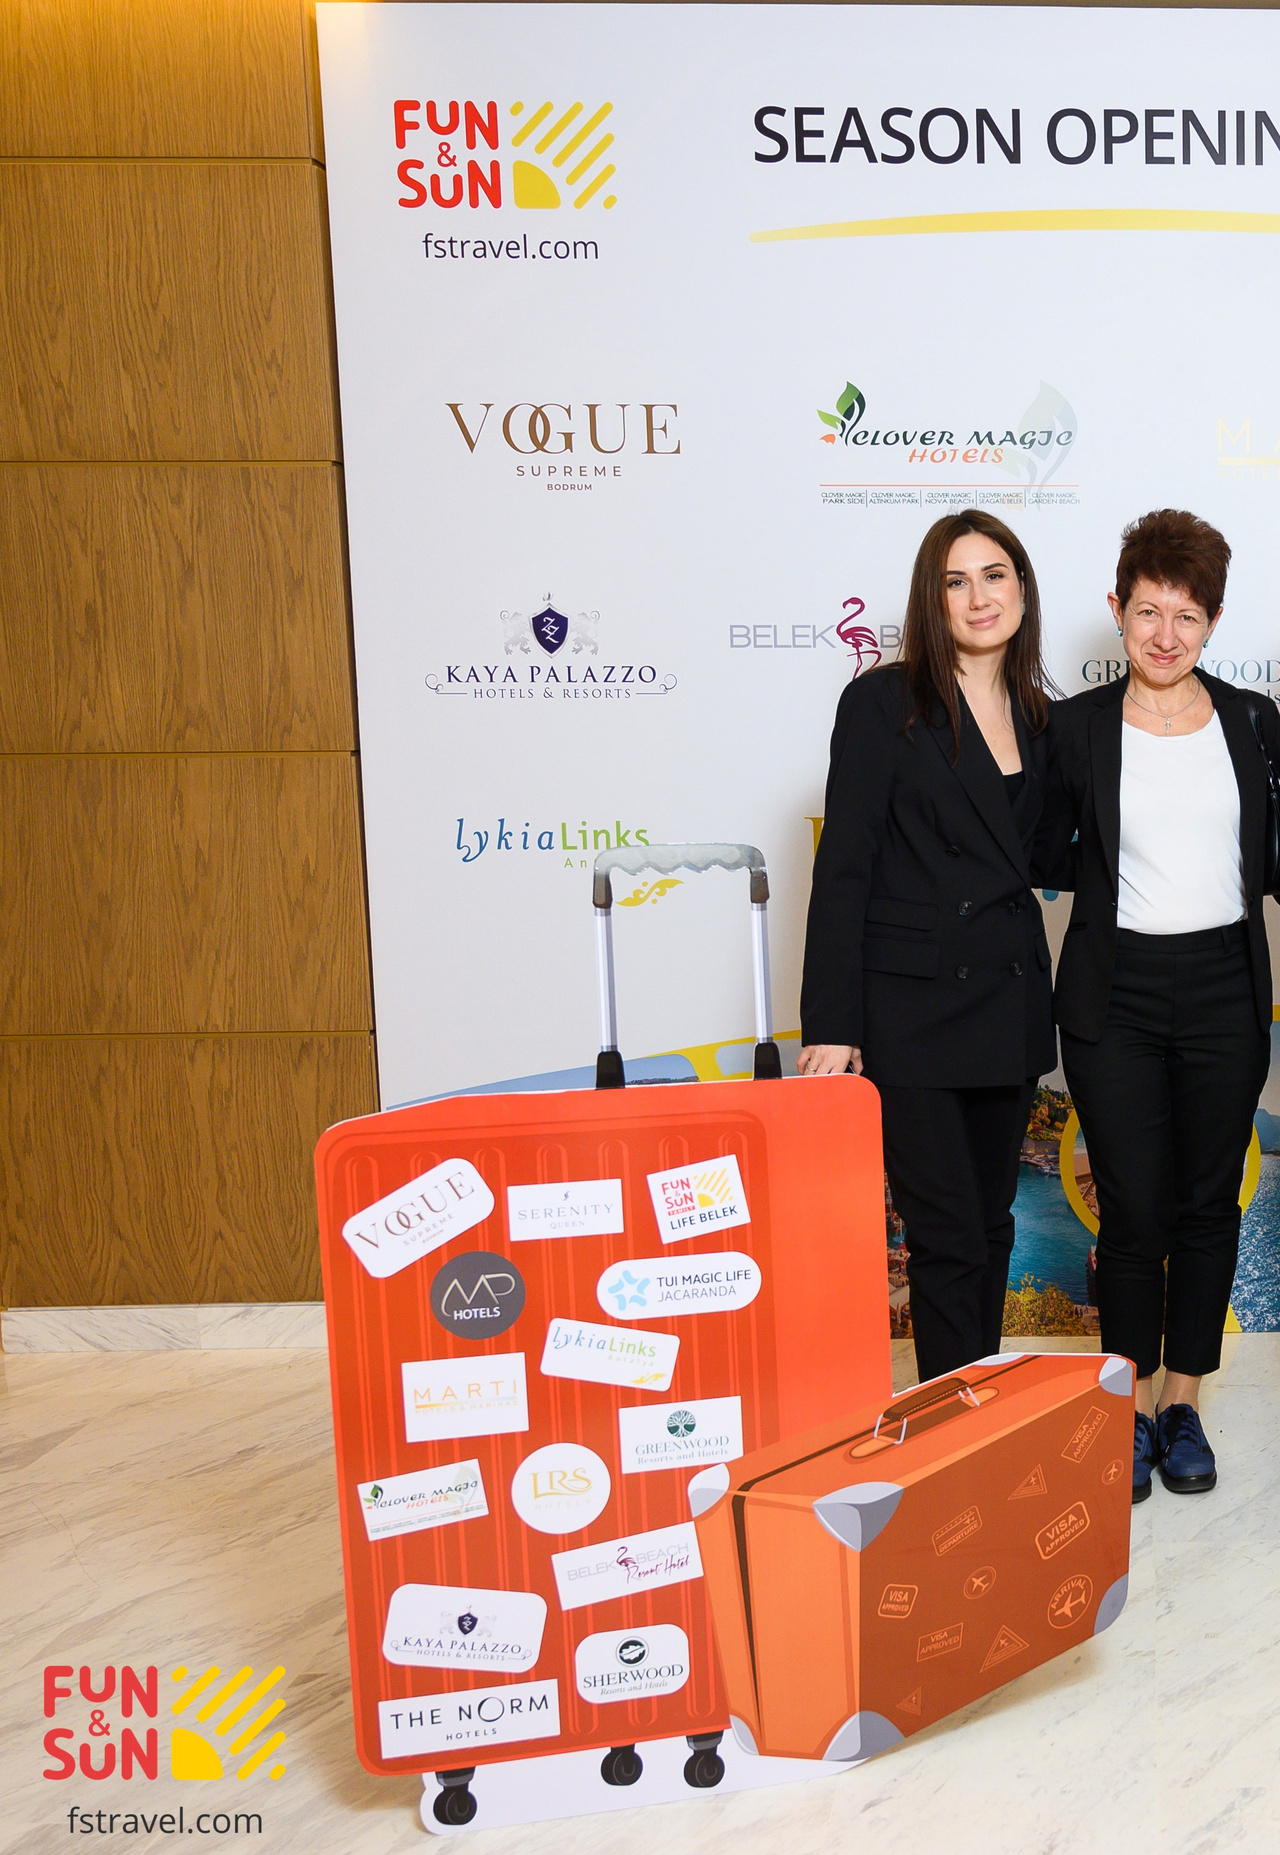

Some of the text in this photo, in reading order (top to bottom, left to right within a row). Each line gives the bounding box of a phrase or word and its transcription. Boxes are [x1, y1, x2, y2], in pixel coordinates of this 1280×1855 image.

[394, 100, 499, 150] FUN
[754, 106, 1021, 164] SEASON
[437, 141, 457, 167] &
[422, 233, 599, 259] fstravel.com
[445, 403, 681, 454] VOGUE
[852, 430, 1073, 449] CLOVER MAGIC
[908, 448, 1004, 464] HOTELS
[516, 465, 622, 477] SUPREME
[547, 483, 593, 491] BODRUM
[729, 624, 837, 649] BELEK
[446, 665, 657, 683] KAYA PALAZZO
[473, 687, 631, 699] HOTELS & RESORTS
[661, 1177, 691, 1195] FUN
[355, 1171, 475, 1249] VOGUE
[518, 1203, 613, 1220] SERENITY
[670, 1215, 696, 1230] LIFE
[699, 1205, 738, 1222] BELEK
[403, 1213, 454, 1247] SUPREME
[550, 1221, 585, 1229] QUEEN
[656, 1269, 751, 1287] TUI MAGIC LIFE
[657, 1285, 737, 1302] JACARANDA
[453, 1306, 501, 1320] HOTELS
[553, 1326, 656, 1357] lykiaLinks
[414, 1380, 517, 1403] MARTI
[1072, 1424, 1089, 1444] VISA
[1073, 1413, 1103, 1459] APPROVED
[635, 1435, 729, 1455] GREENWOOD
[637, 1455, 674, 1464] Resorts
[677, 1452, 694, 1461] and
[531, 1467, 593, 1499] LRS
[380, 1492, 426, 1508] CLOVER
[1045, 1519, 1085, 1554] APPROVED
[1046, 1513, 1077, 1540] VISA
[567, 1543, 690, 1581] BELEK BEACH
[889, 1590, 909, 1602] VISA
[1051, 1578, 1086, 1609] ARRIVAL
[882, 1603, 909, 1612] APPROVED
[403, 1636, 522, 1654] KAYA PALAZZO
[920, 1635, 960, 1654] APPROVED
[930, 1631, 948, 1643] VISA
[583, 1664, 684, 1689] SHERWOOD
[390, 1694, 549, 1730] THE NORM
[446, 1727, 497, 1741] HOTELS
